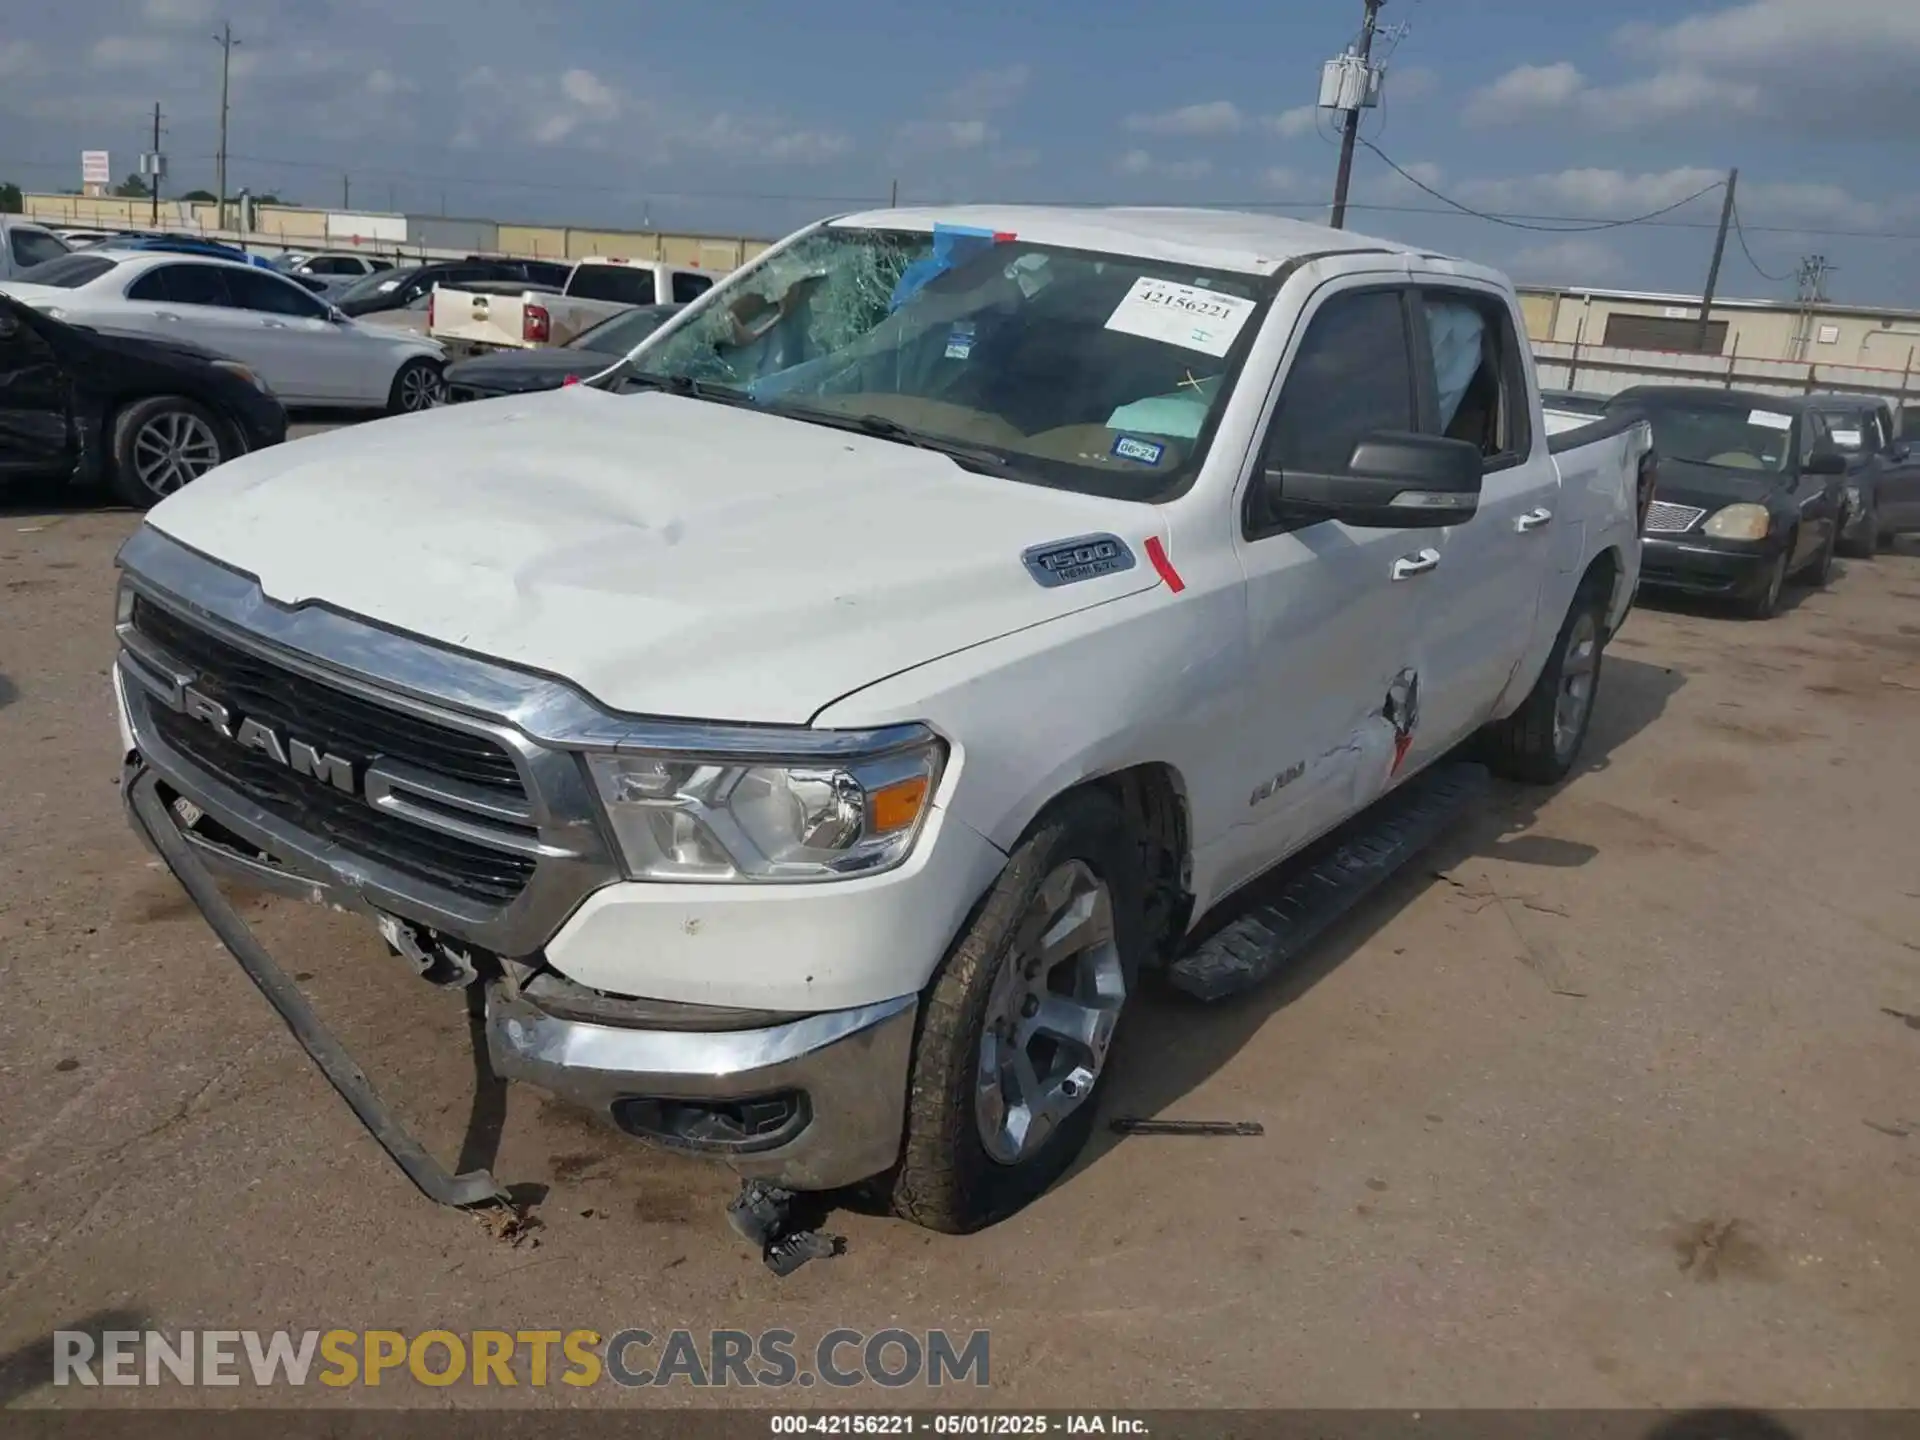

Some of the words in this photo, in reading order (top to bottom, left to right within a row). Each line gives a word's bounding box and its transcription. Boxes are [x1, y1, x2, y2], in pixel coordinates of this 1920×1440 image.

[1139, 290, 1232, 319] 42156221
[1039, 541, 1118, 570] 1500
[1057, 564, 1091, 581] HEMI
[185, 686, 355, 794] RAM
